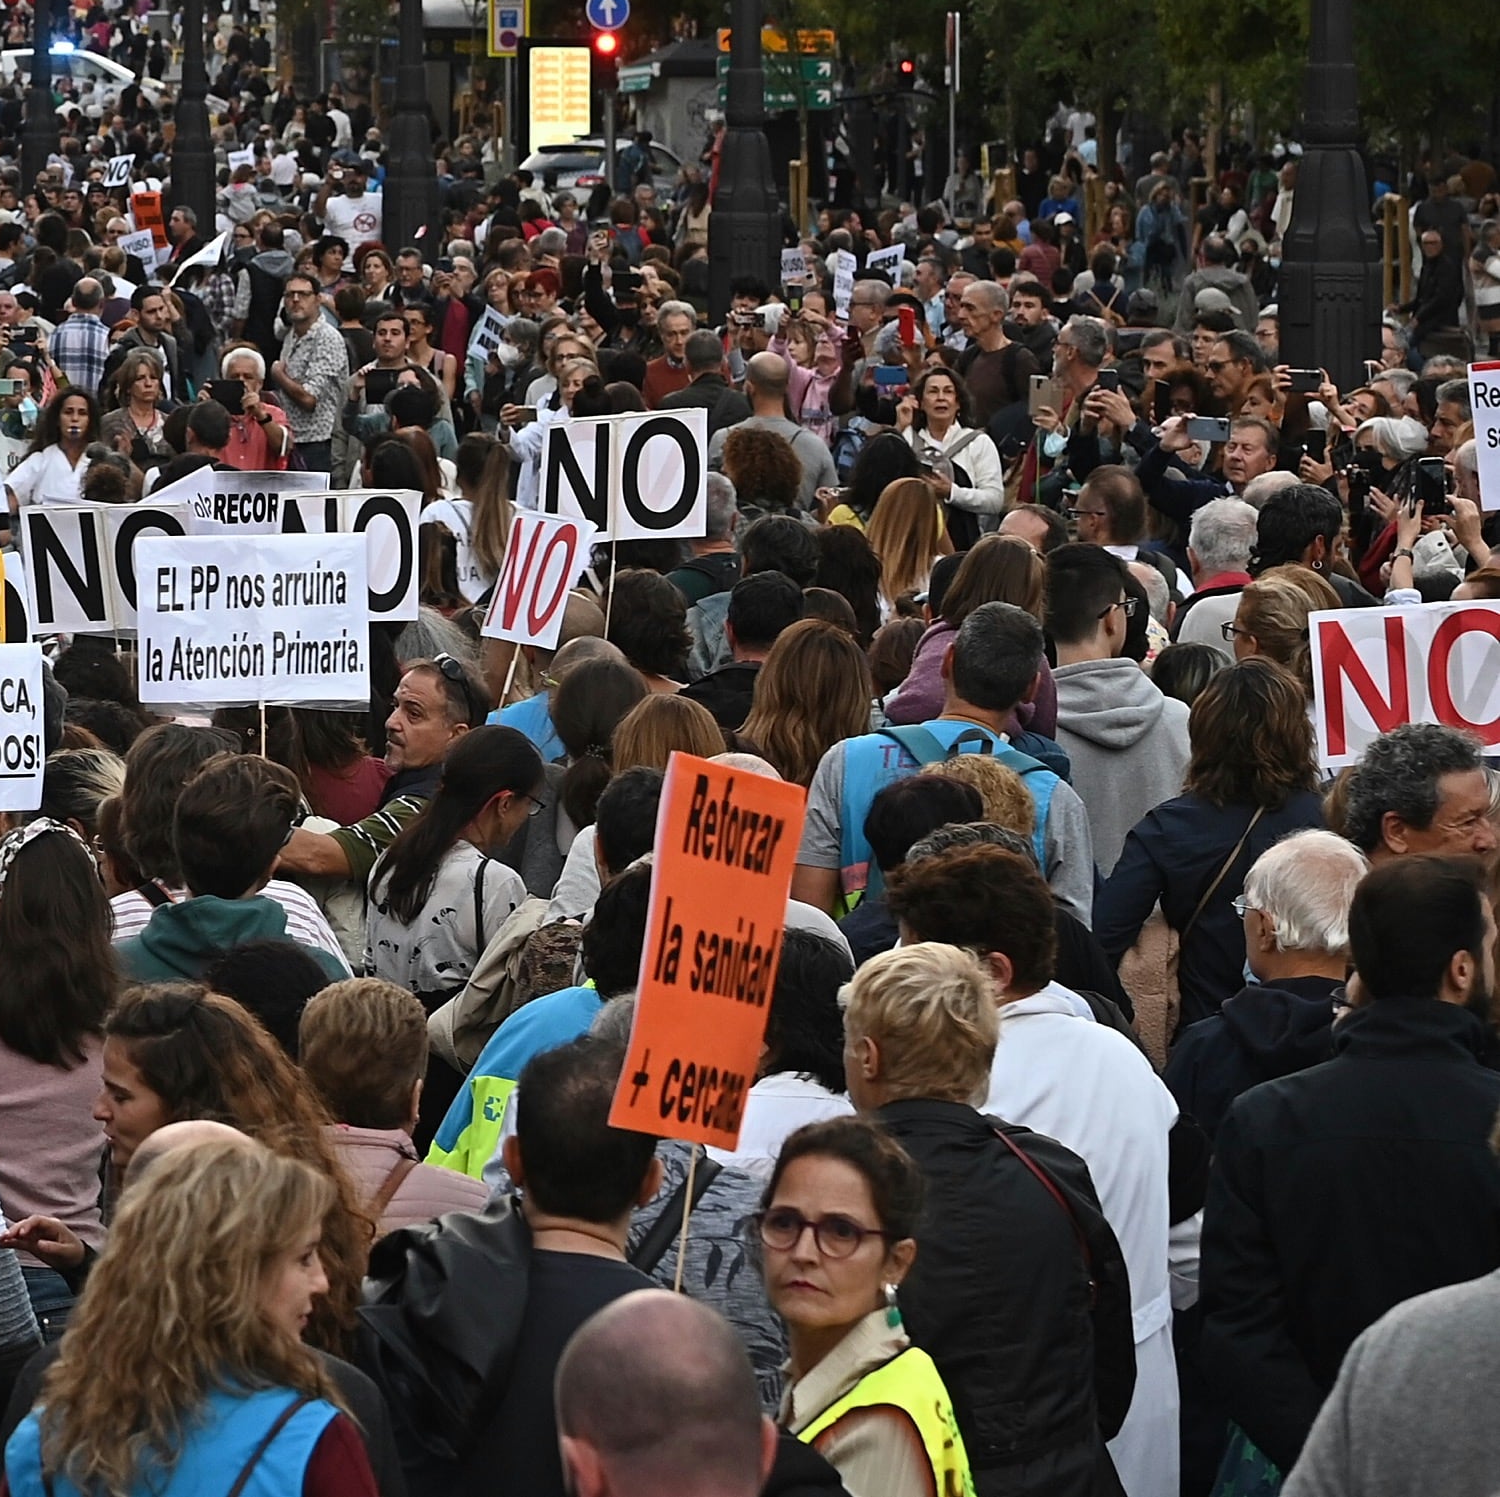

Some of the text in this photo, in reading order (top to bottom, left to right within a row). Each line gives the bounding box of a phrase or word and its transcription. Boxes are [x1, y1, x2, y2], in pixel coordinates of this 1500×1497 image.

[544, 421, 702, 534] NO
[156, 560, 347, 613] EL PP nos arruina
[485, 517, 578, 637] NO
[145, 629, 365, 683] la Atención Primaria.
[1318, 607, 1500, 756] NO
[682, 773, 785, 876] Reforzar
